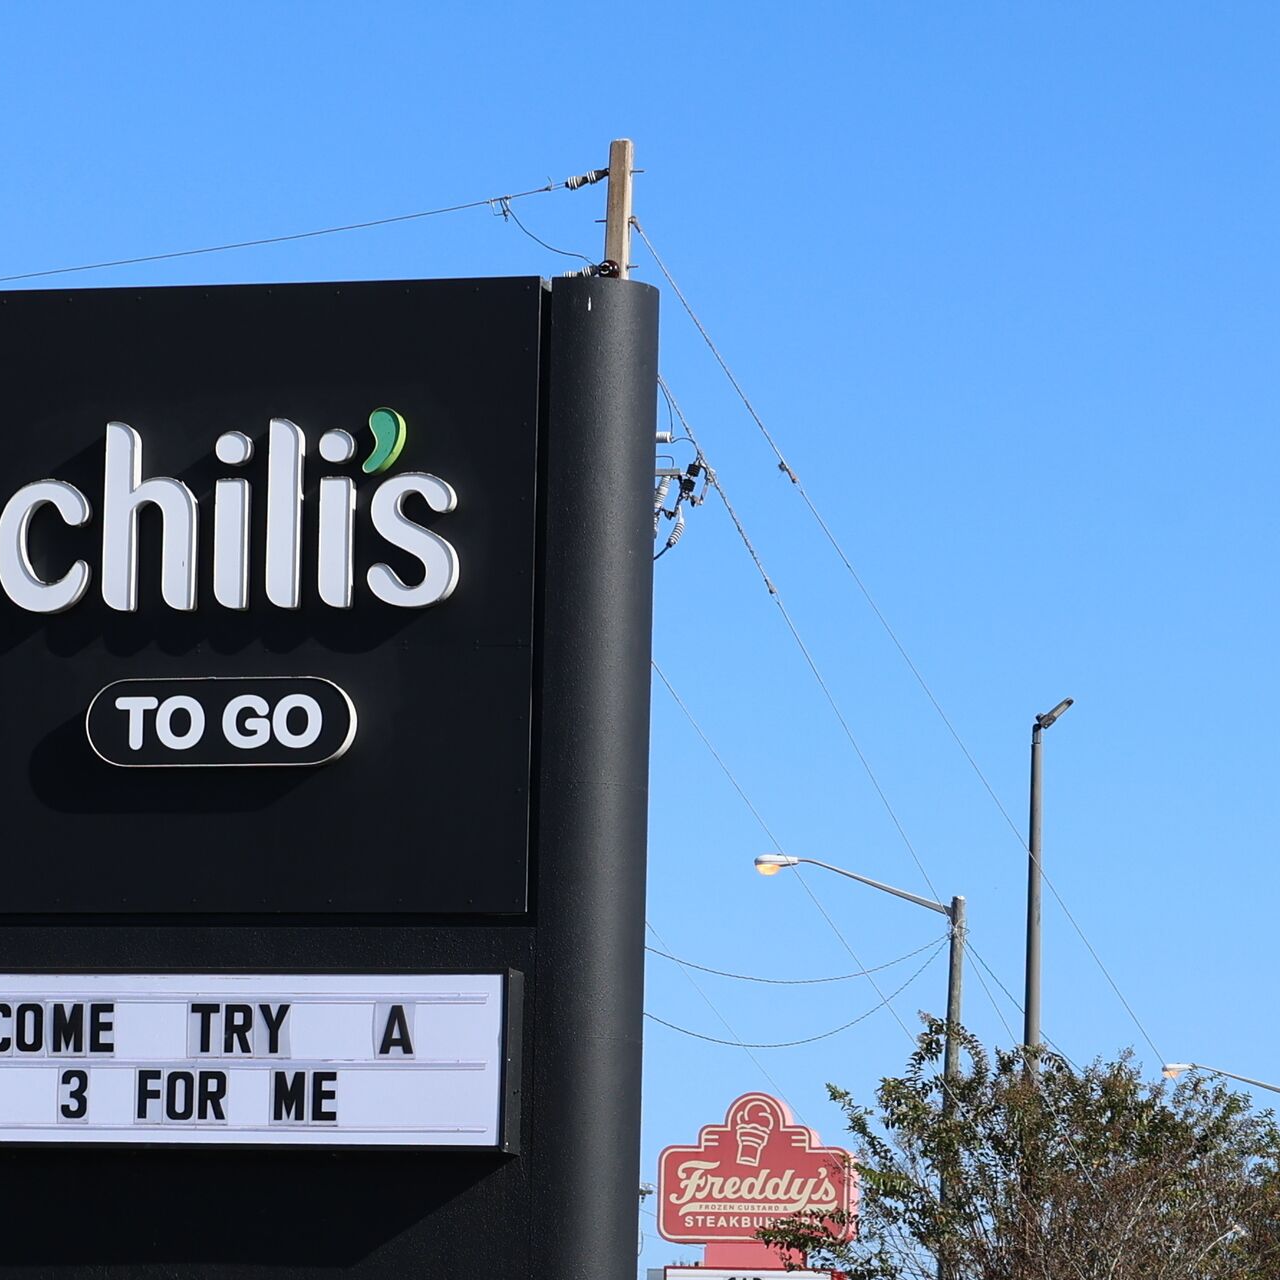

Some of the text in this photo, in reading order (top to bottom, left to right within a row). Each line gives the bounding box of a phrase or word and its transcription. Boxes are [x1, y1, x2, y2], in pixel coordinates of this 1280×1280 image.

[115, 694, 323, 751] TO GO
[191, 1003, 291, 1055] TRY
[379, 1004, 414, 1055] A
[60, 1069, 338, 1121] 3 FOR ME
[670, 1161, 837, 1211] Freddy's
[738, 1204, 779, 1212] CUSTARD
